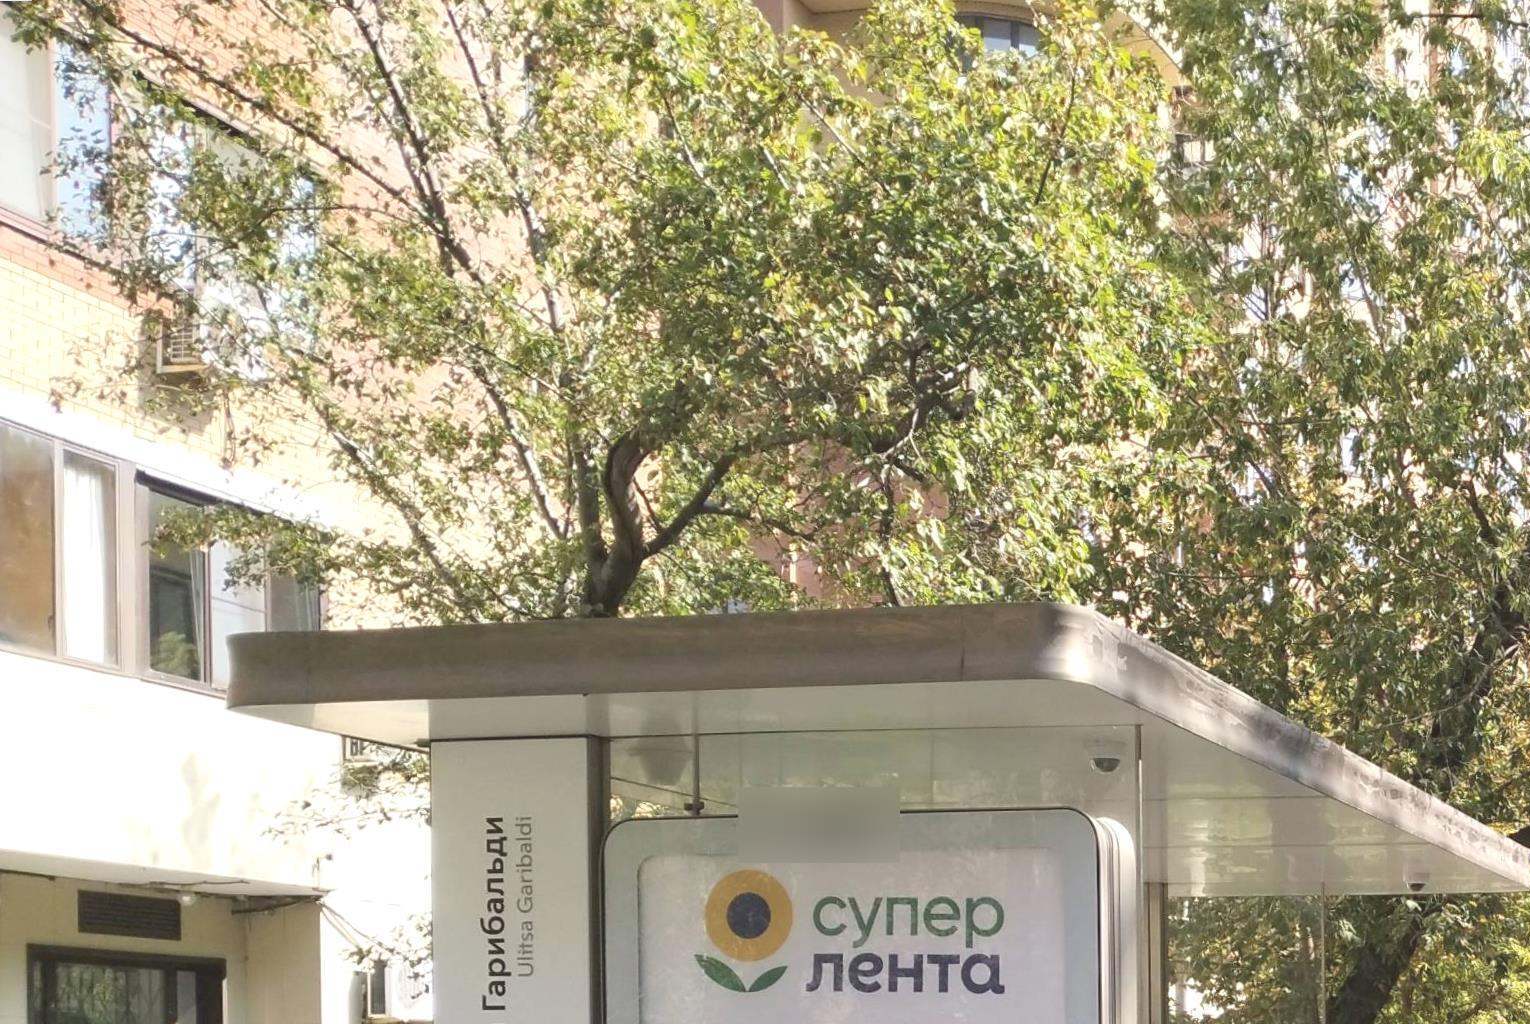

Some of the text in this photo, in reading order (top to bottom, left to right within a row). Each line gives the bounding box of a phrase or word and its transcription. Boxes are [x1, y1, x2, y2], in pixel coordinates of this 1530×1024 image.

[480, 816, 511, 1011] Гарибальди
[516, 816, 534, 977] Ulitsa Garibaldi
[812, 896, 1005, 948] супер
[805, 952, 1005, 995] лента
